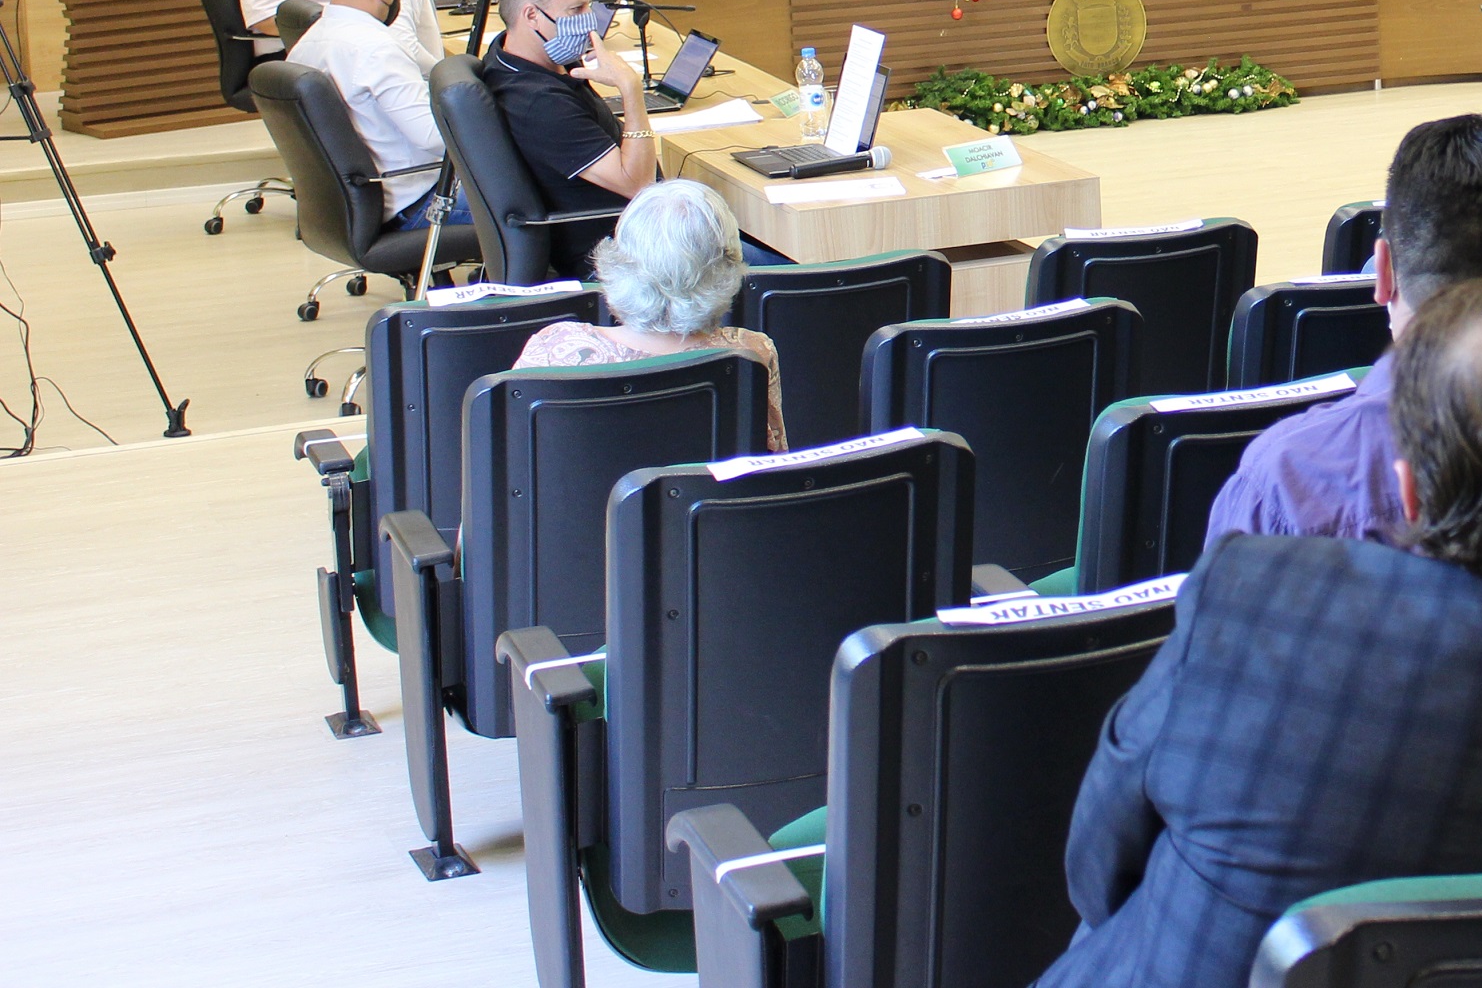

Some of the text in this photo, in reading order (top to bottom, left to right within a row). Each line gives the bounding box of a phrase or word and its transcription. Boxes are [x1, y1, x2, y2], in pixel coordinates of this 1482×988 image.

[968, 145, 992, 153] MOACIR
[965, 151, 1003, 163] DALCHIAVAN
[455, 286, 516, 299] SENTAR
[1188, 393, 1269, 405] SENTAR
[749, 448, 834, 466] SENTAR
[992, 600, 1105, 620] SENTAR
